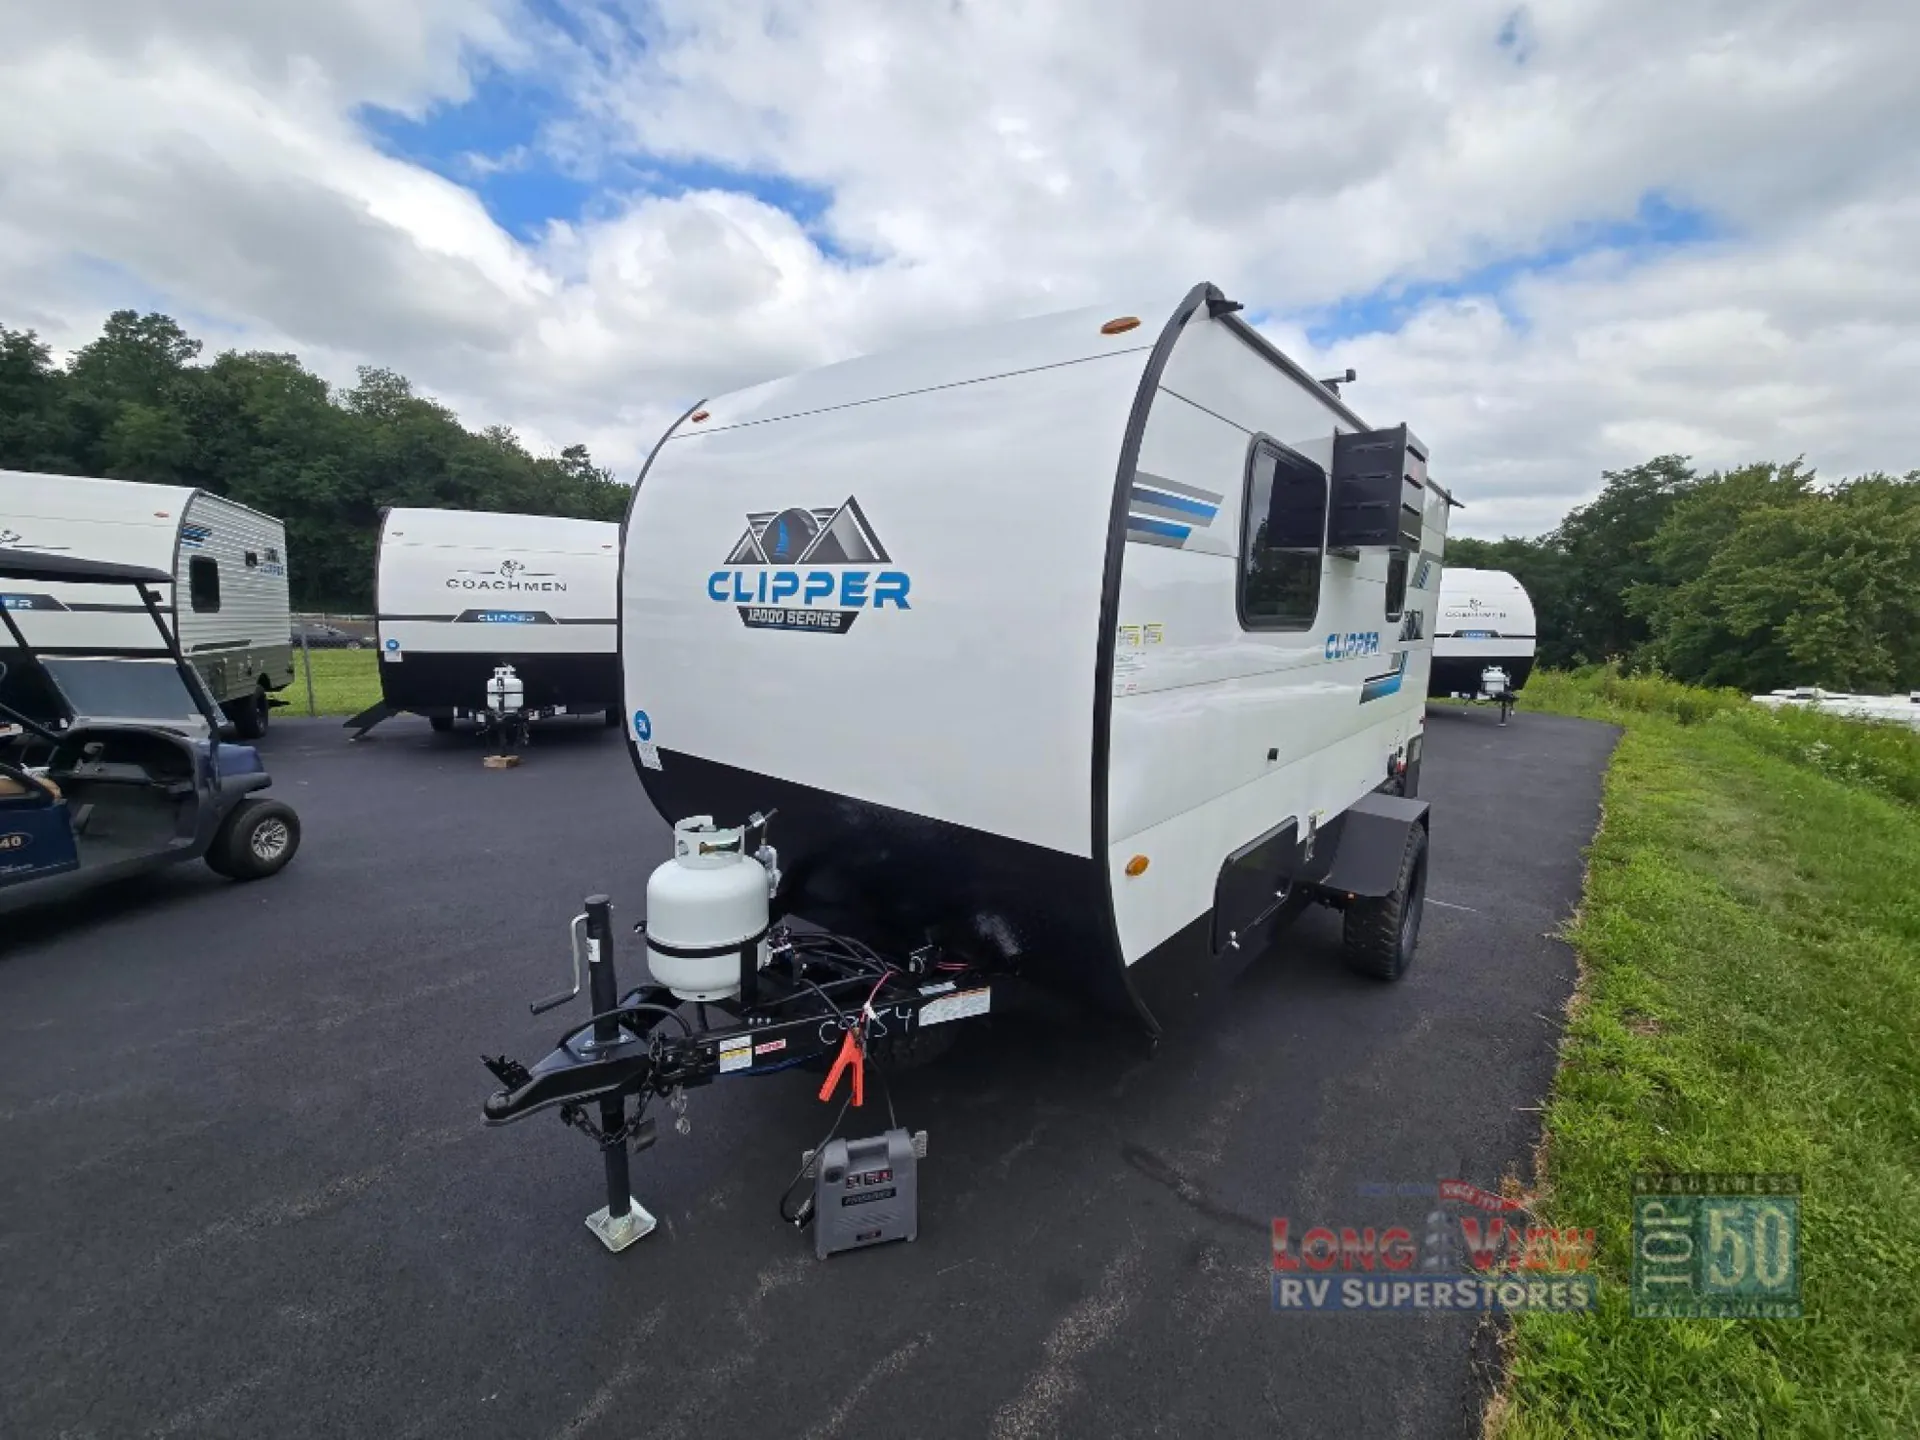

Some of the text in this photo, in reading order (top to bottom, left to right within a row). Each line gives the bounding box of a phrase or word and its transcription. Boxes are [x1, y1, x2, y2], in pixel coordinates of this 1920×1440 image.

[446, 578, 568, 592] COACHMEN
[708, 571, 912, 610] CLIPPER
[748, 608, 843, 628] 12000 SERIES
[1325, 632, 1380, 660] CLIPPER
